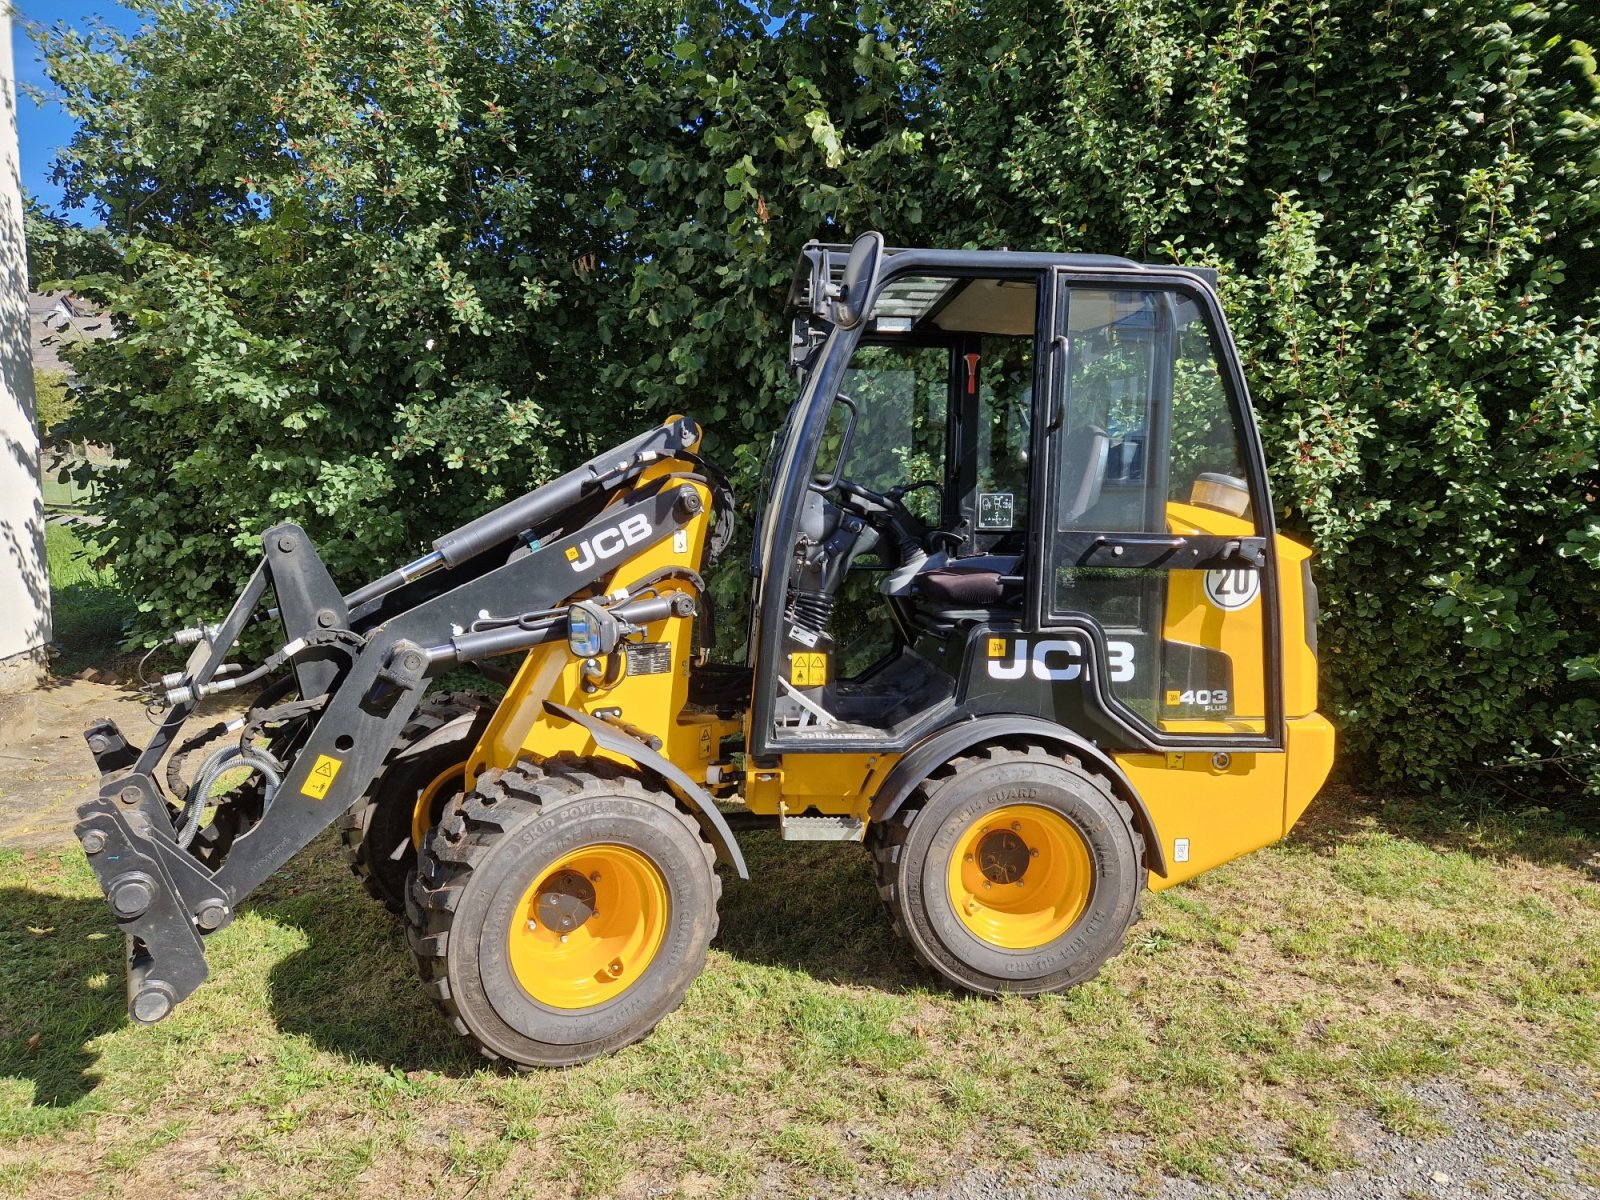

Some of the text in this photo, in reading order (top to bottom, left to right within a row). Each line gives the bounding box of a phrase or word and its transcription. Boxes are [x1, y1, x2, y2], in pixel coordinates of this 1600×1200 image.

[571, 513, 653, 572] JCB
[1214, 569, 1250, 595] 20
[987, 639, 1136, 682] JCB
[1180, 690, 1228, 705] 403
[987, 786, 1038, 805] GUARD
[522, 817, 556, 845] SKID
[560, 801, 611, 820] POWER
